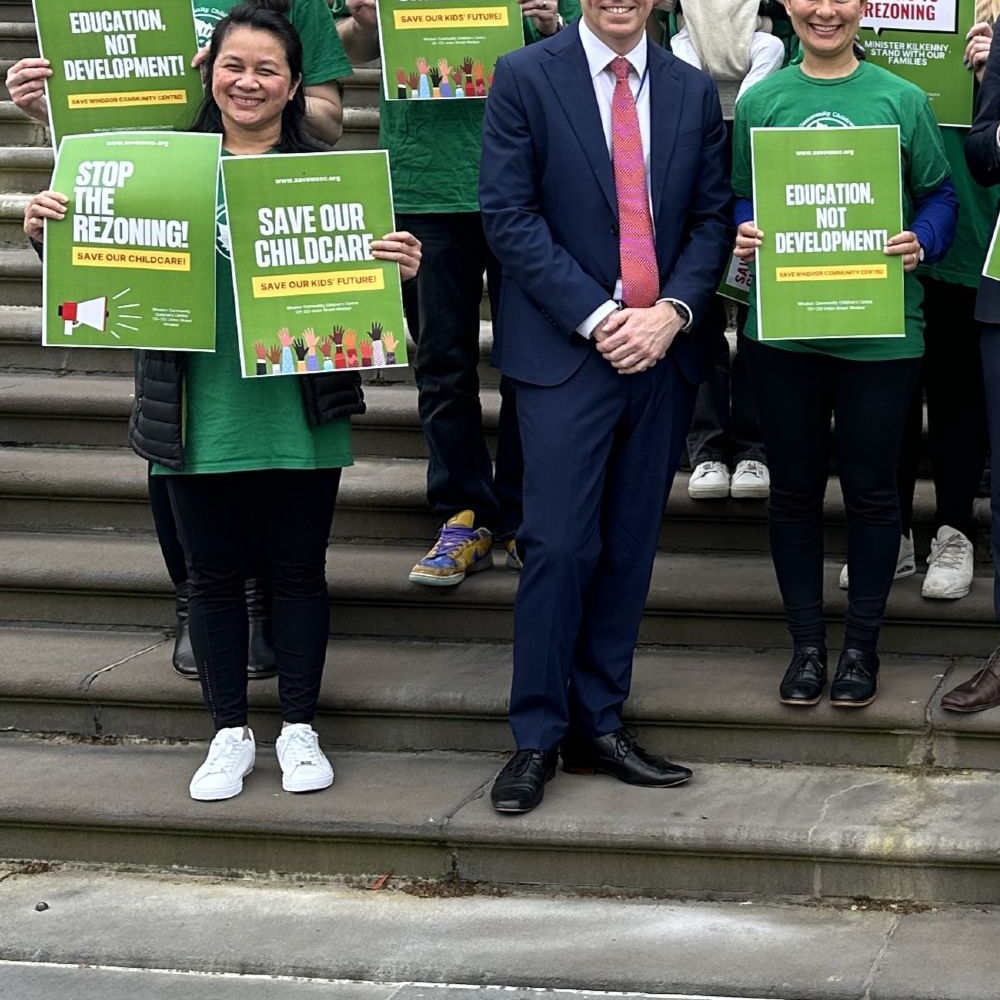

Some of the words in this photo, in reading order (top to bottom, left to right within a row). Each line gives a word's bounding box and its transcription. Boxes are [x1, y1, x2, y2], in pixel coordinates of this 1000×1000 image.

[69, 9, 167, 34] EDUCATION,
[401, 15, 424, 23] SAVE
[425, 14, 443, 22] OUR
[445, 14, 465, 22] KIDS'
[467, 12, 502, 21] FUTURE!
[865, 2, 935, 20] REZONING
[104, 34, 137, 55] NOT
[864, 40, 905, 49] MINISTER
[871, 49, 900, 57] STAND
[902, 50, 925, 58] WITH
[927, 51, 945, 60] OUR
[64, 56, 185, 81] DEVELOPMENT!
[888, 57, 927, 66] FAMILIES
[76, 161, 134, 188] STOP
[74, 187, 115, 216] THE
[786, 183, 875, 206] EDUCATION,
[258, 206, 317, 237] SAVE
[320, 203, 365, 232] OUR
[816, 208, 846, 228] NOT
[72, 214, 189, 249] REZONING!
[775, 230, 888, 254] DEVELOPMENT!
[77, 252, 103, 262] SAVE
[106, 254, 126, 263] OUR
[128, 255, 186, 266] CHILDCARE!
[254, 233, 375, 268] CHILDCARE
[260, 281, 287, 291] SAVE
[289, 280, 309, 289] OUR
[311, 278, 335, 288] KIDS'
[338, 276, 377, 286] FUTURE!
